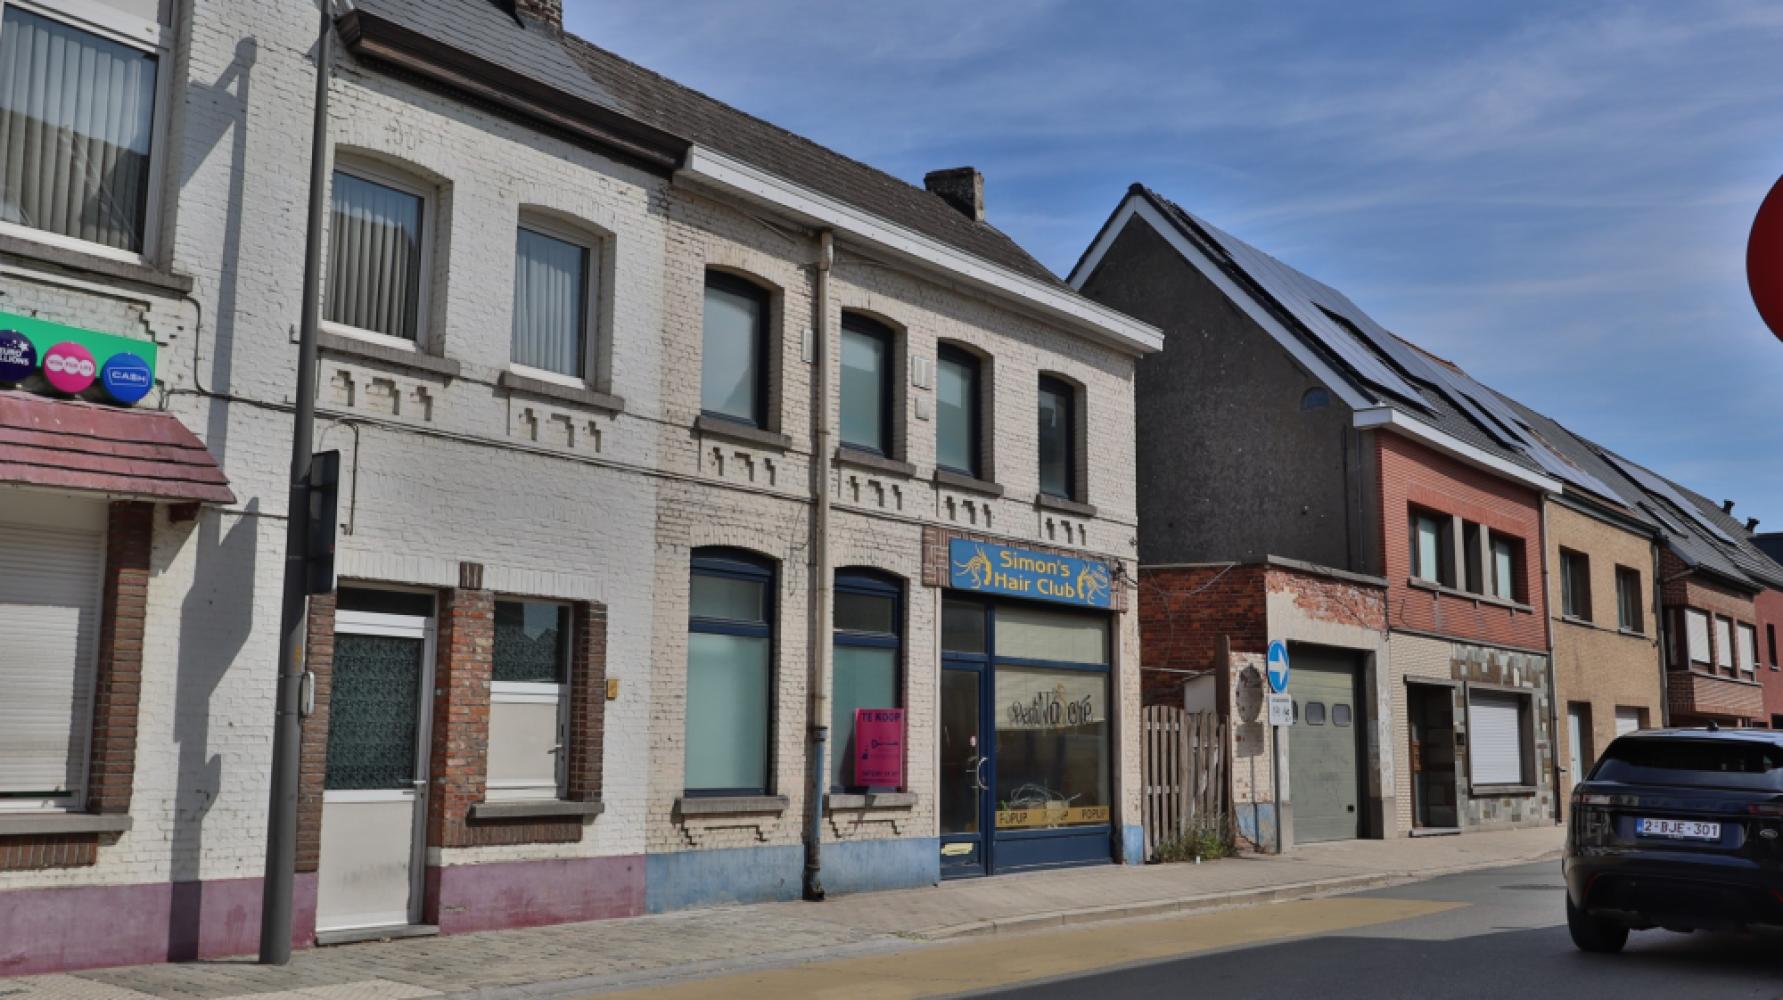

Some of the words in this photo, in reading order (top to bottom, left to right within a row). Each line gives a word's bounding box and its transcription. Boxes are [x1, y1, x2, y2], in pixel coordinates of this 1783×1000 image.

[112, 370, 146, 383] CASH
[1000, 550, 1071, 577] Simon's
[994, 571, 1031, 592] Hair
[1037, 578, 1076, 598] Club
[875, 712, 901, 722] KOOP
